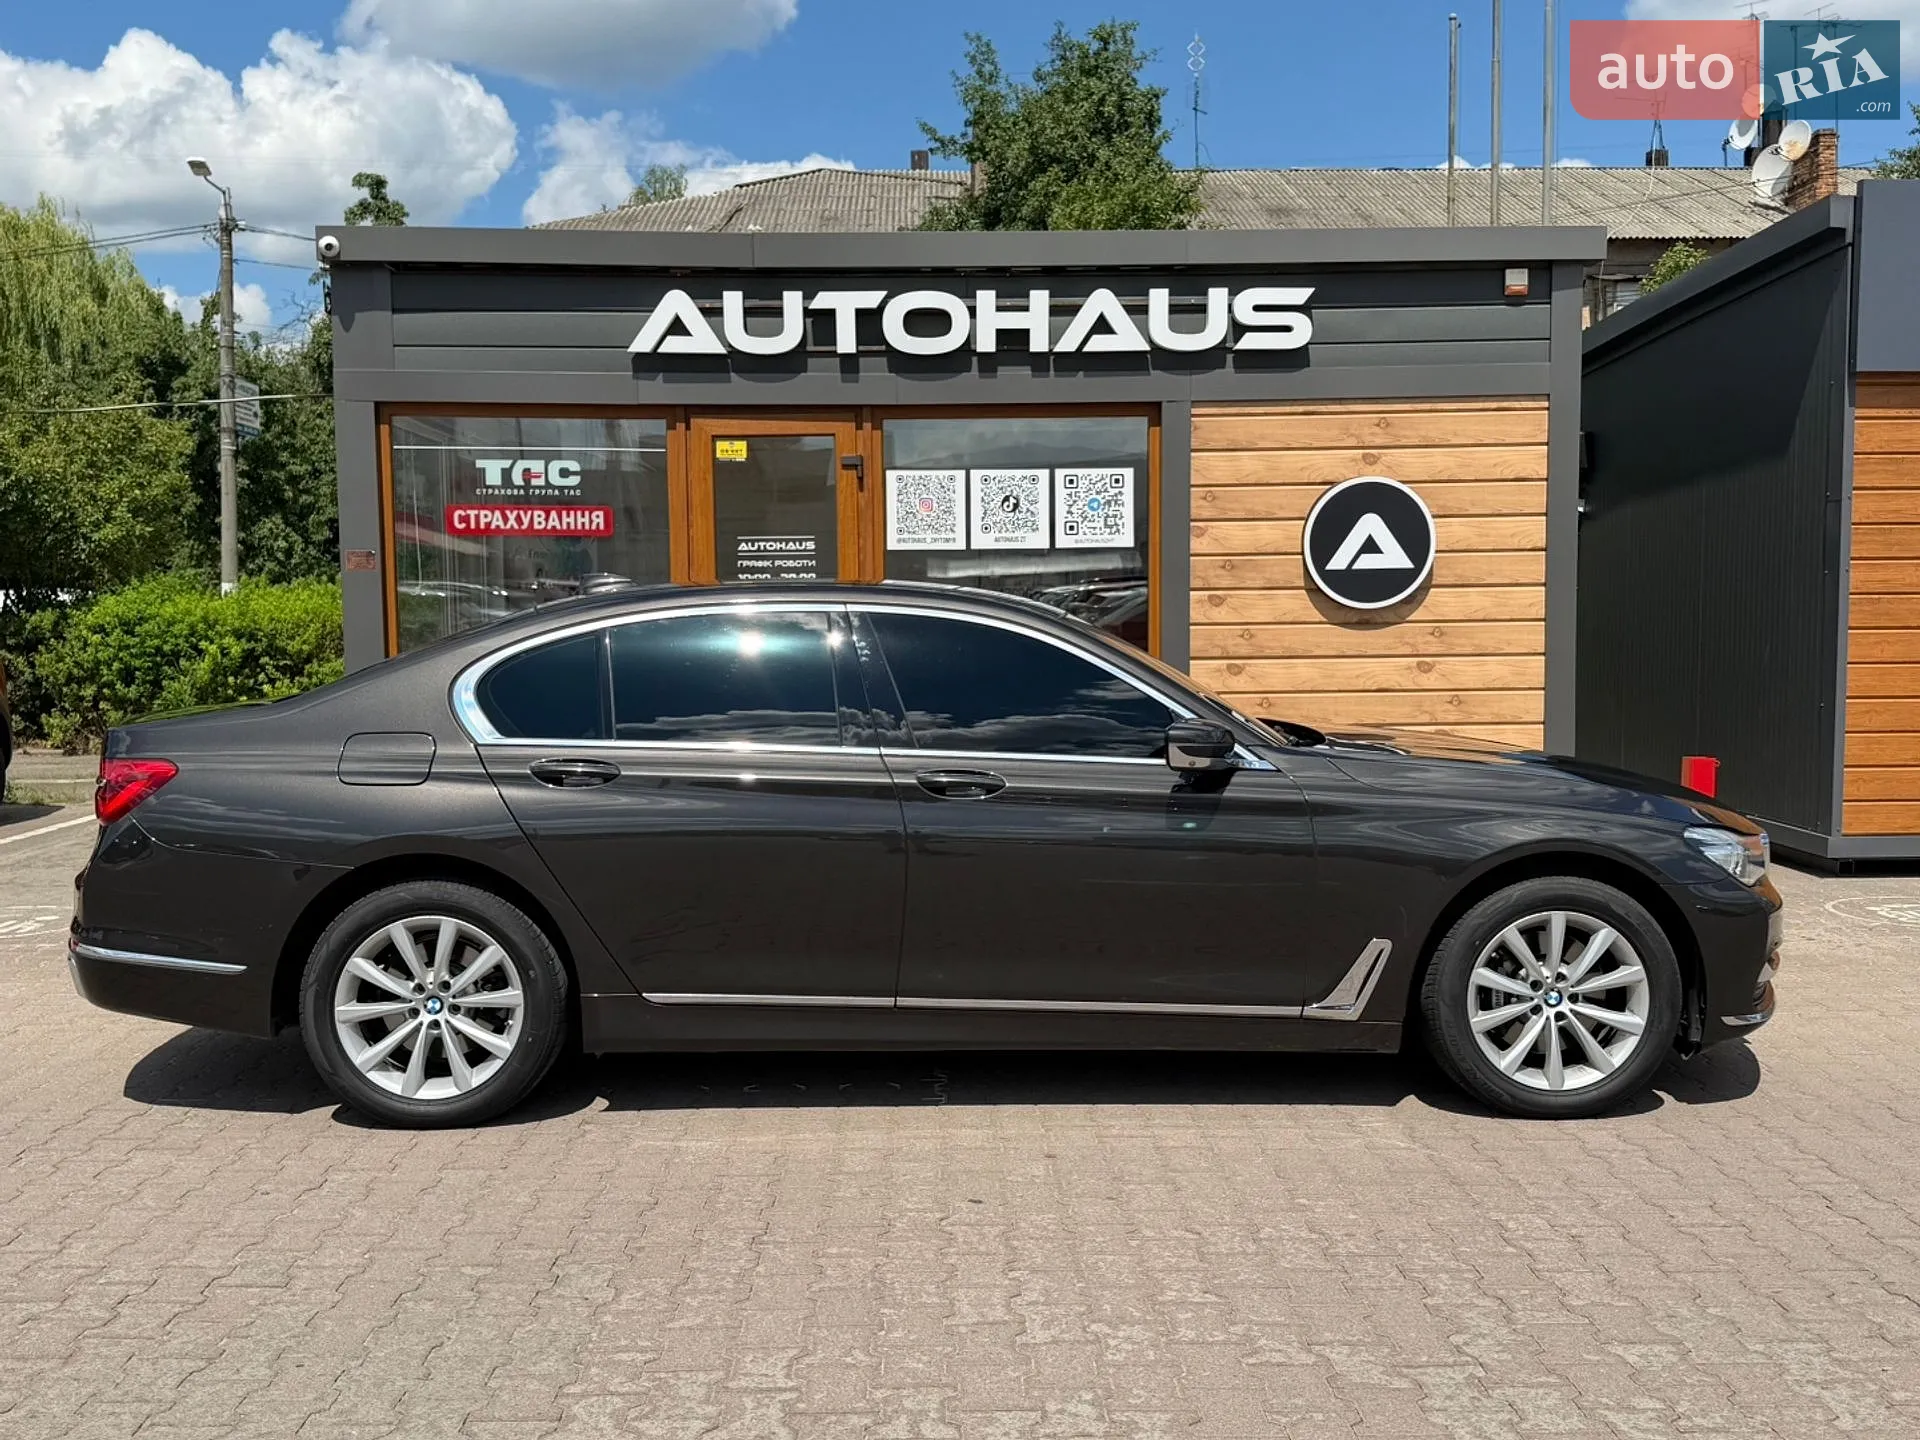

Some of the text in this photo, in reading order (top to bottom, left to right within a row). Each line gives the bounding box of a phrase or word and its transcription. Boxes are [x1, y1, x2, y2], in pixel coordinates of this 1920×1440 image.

[627, 287, 1315, 355] AUTOHAUS
[475, 488, 525, 496] СТРАХОВА
[529, 488, 559, 496] ГРУПА
[453, 509, 604, 530] СТРАХУВАННЯ
[737, 541, 816, 551] AUTOHAUS
[774, 560, 816, 568] РОБОТИ
